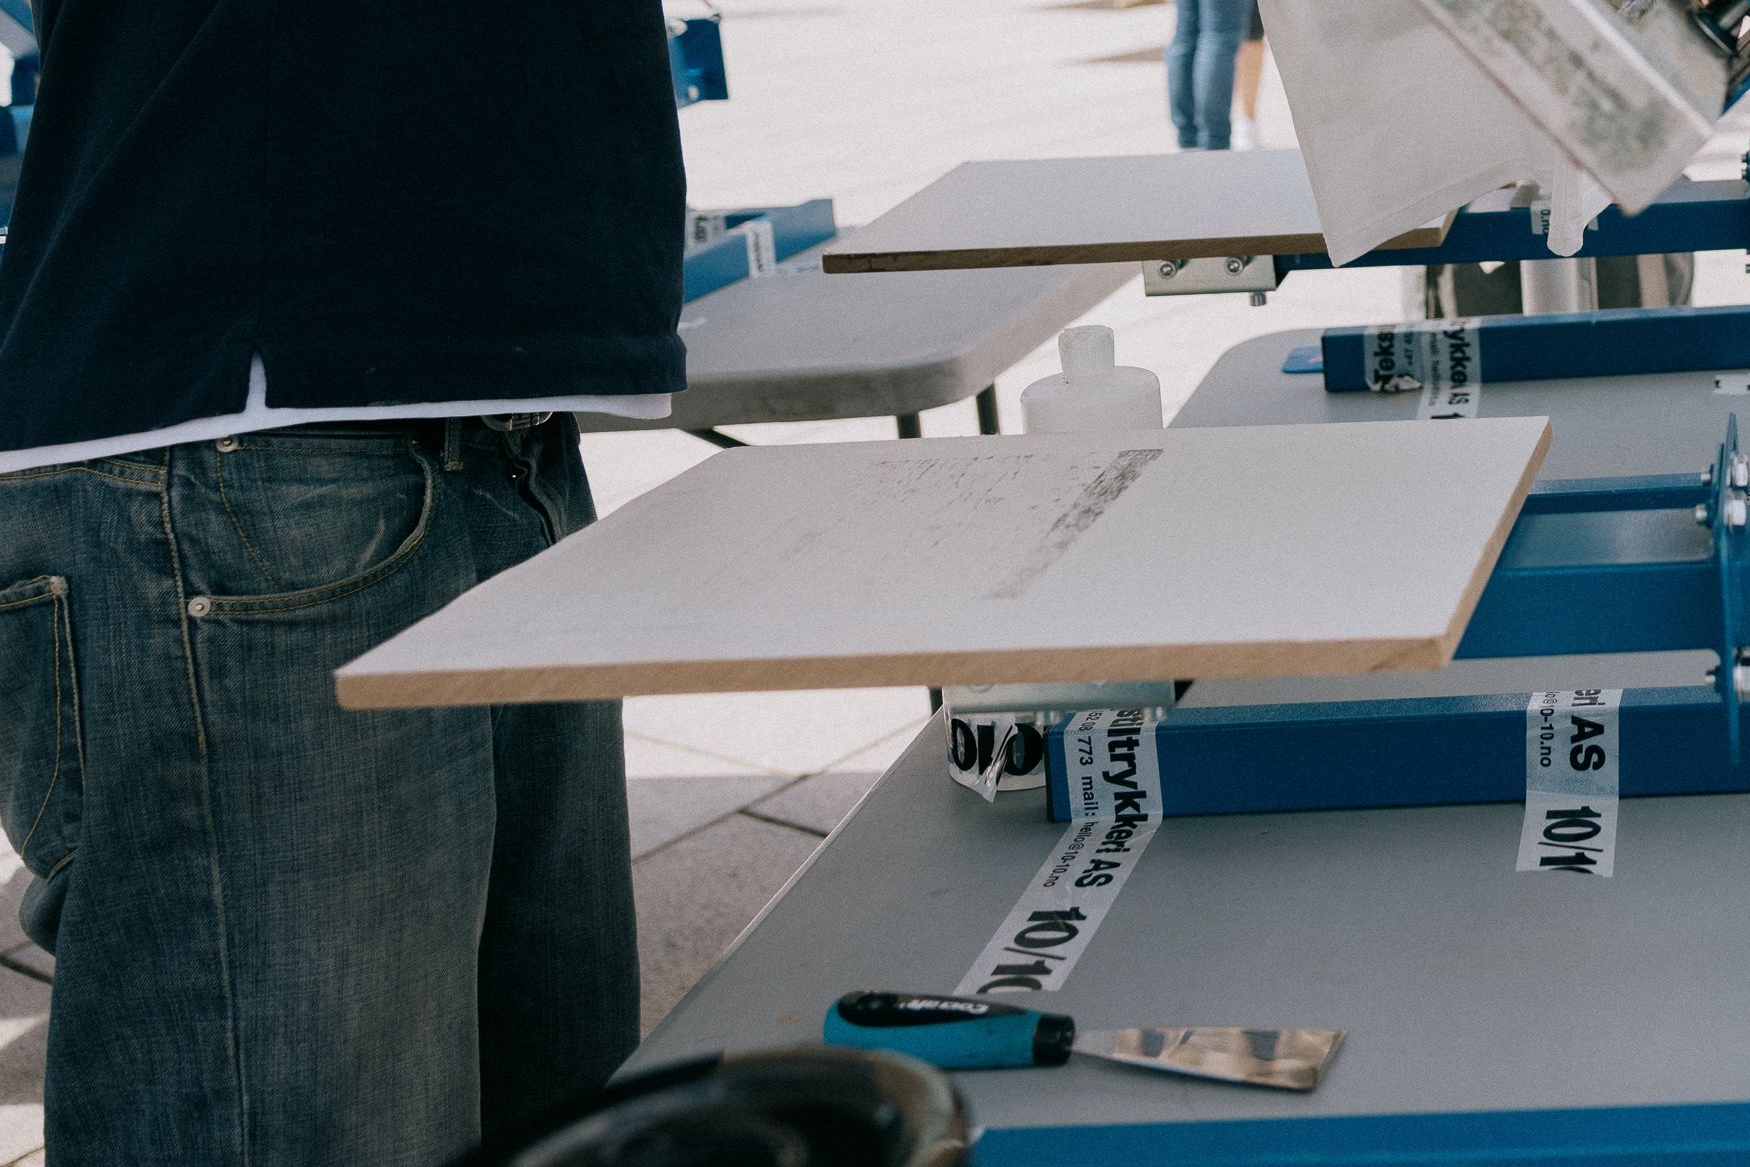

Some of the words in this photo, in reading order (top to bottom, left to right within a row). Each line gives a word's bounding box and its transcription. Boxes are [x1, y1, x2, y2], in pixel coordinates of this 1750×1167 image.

[1077, 736, 1094, 766] 773
[1569, 715, 1606, 772] AS
[1081, 776, 1099, 817] mail:
[1043, 821, 1100, 888] hello@10-10.no
[1537, 805, 1605, 875] 10/1
[1074, 859, 1121, 889] AS
